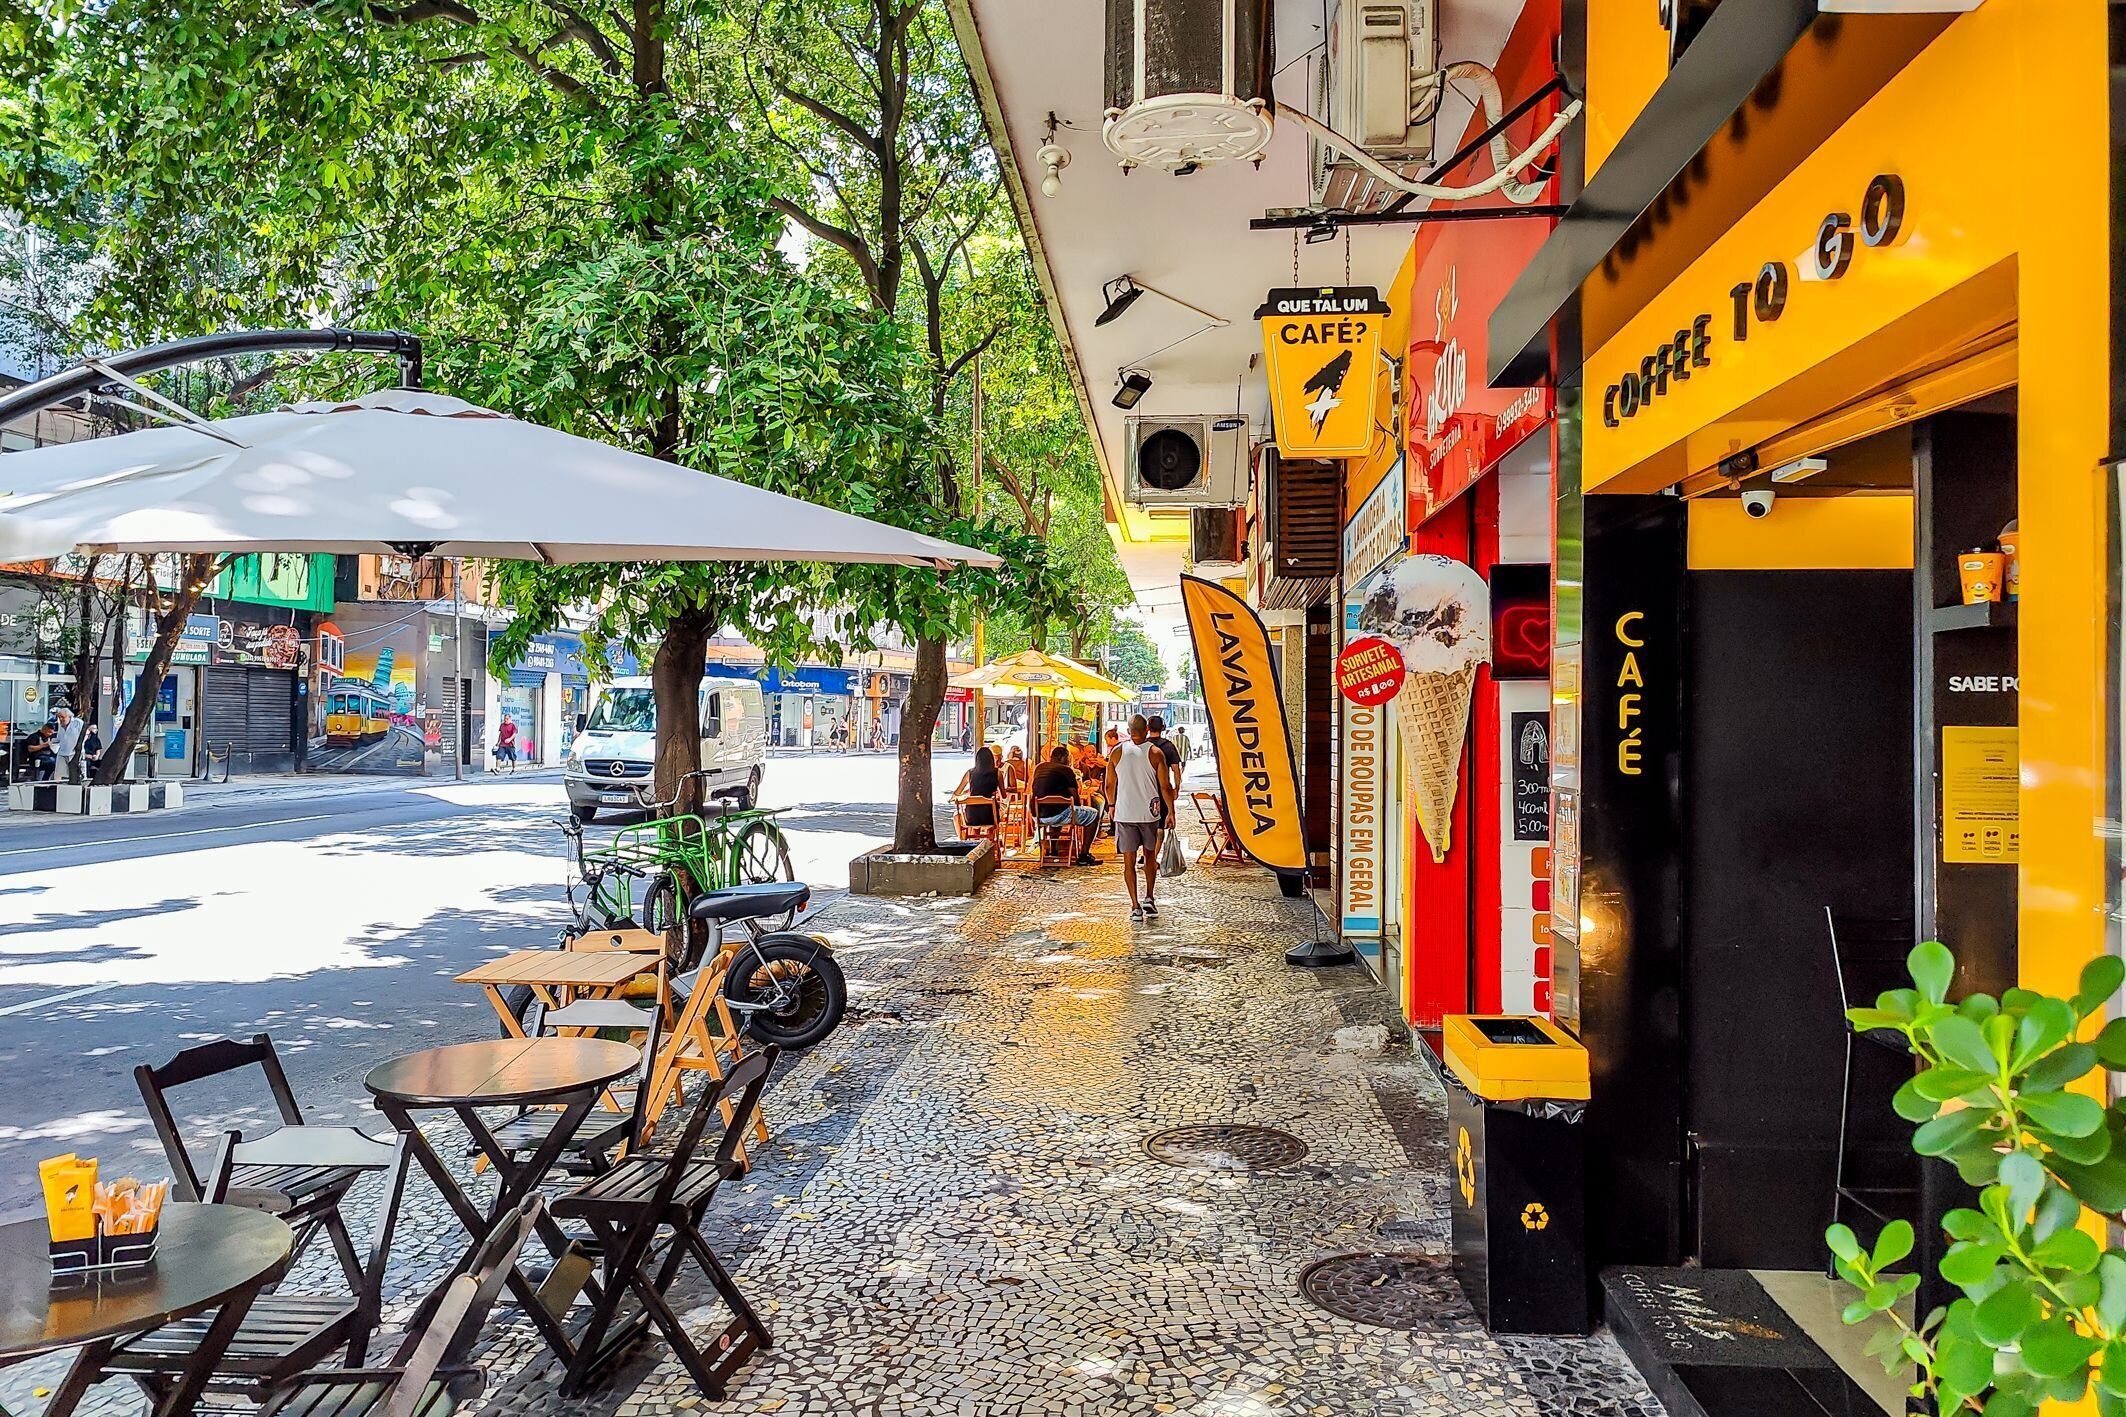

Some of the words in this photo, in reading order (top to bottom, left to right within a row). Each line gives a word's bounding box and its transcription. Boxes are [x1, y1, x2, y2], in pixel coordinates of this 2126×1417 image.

[1277, 300, 1311, 313] QUE
[1312, 299, 1341, 312] TAL
[1343, 298, 1368, 312] UM
[1603, 313, 1712, 429] COFFEE
[1730, 260, 1789, 341] TO
[1814, 174, 1905, 281] GO
[1280, 316, 1367, 345] CAFÉ?
[189, 626, 211, 637] SORTE
[170, 652, 207, 662] CUMULADA
[1341, 644, 1388, 672] SORVETE
[781, 680, 819, 688] Ortobom
[1341, 657, 1400, 690] ARTESANAL
[1949, 676, 1999, 692] SABE
[1615, 612, 1645, 775] CAFÉ
[1210, 612, 1276, 836] LAVANDERIA
[1350, 730, 1375, 751] DE
[1350, 756, 1375, 825] ROUPAS
[1518, 780, 1550, 795] 300m
[1350, 829, 1374, 853] EM
[1349, 857, 1374, 912] GERAL
